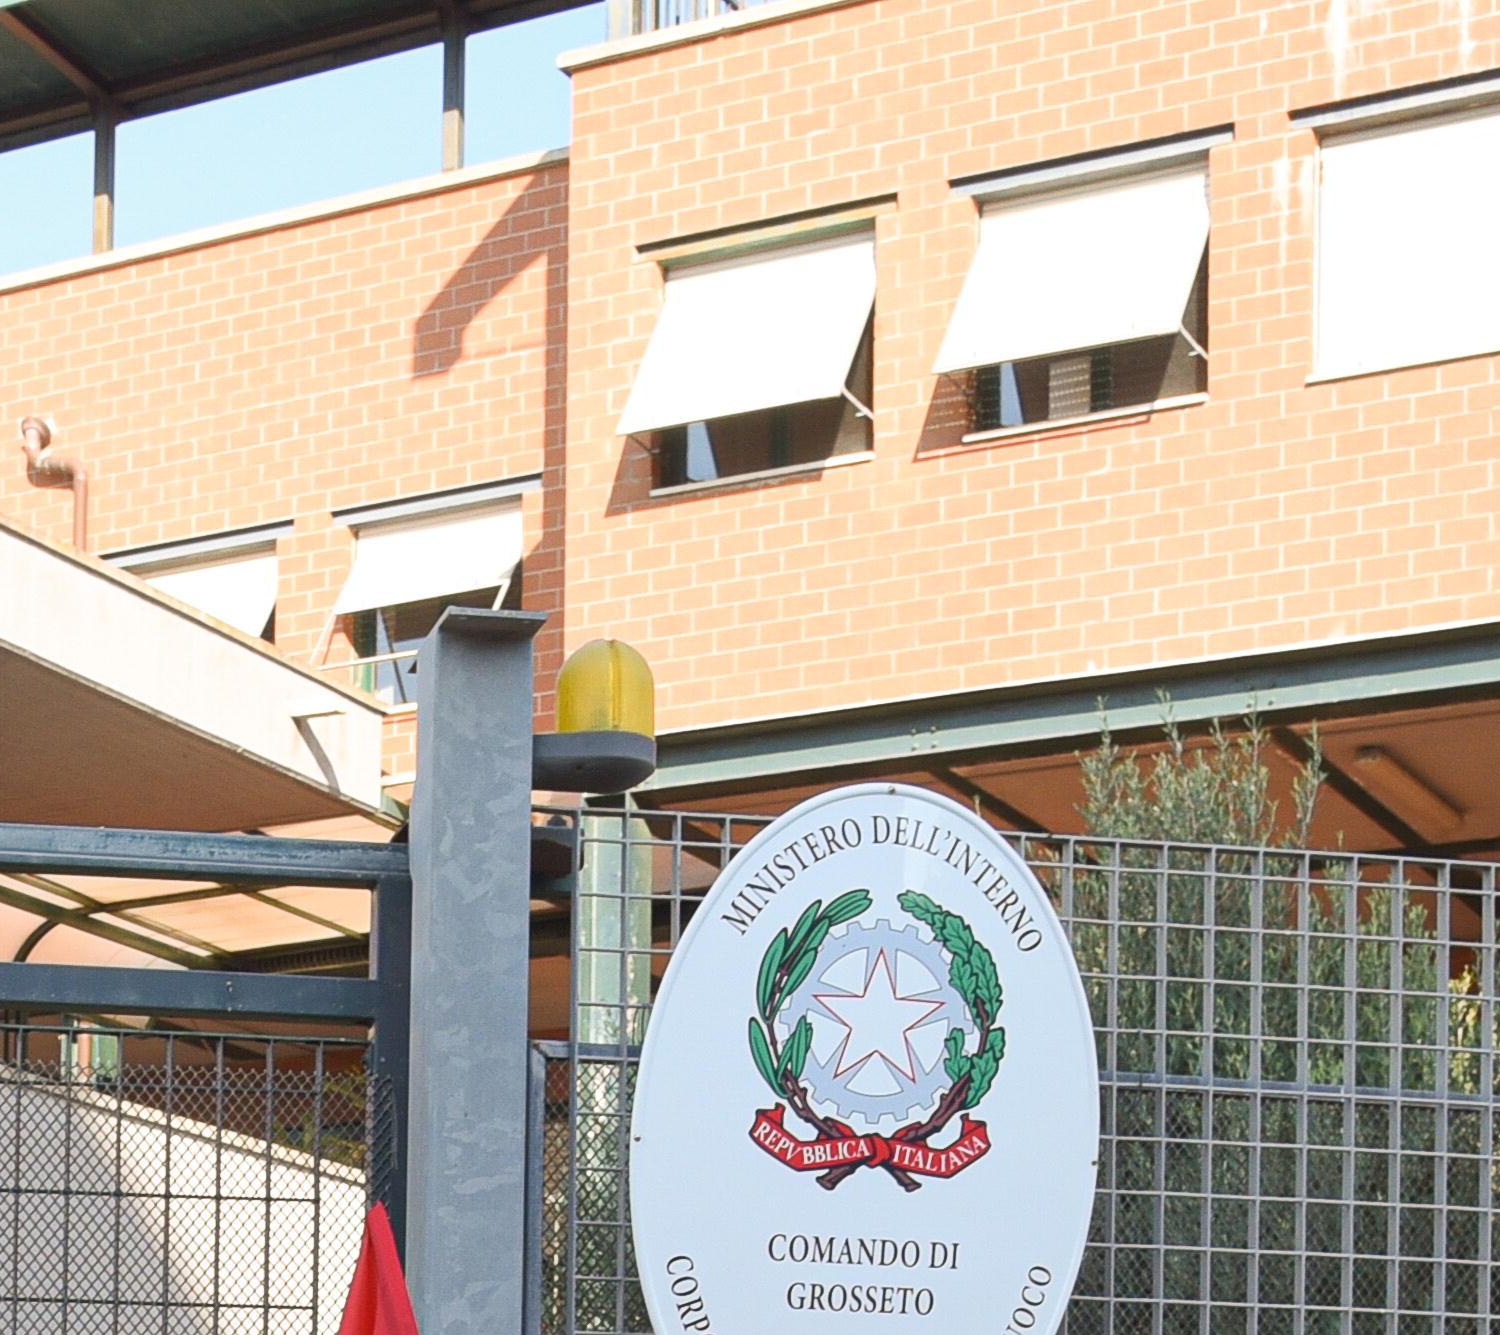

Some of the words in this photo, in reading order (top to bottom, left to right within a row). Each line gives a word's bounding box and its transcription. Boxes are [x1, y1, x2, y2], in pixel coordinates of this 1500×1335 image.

[720, 817, 863, 937] MINISTERO
[872, 814, 1043, 956] DELL'INTERNO
[893, 1134, 988, 1172] ITALIANA
[768, 1233, 920, 1269] COMANDO
[928, 1239, 960, 1270] DI
[786, 1282, 935, 1317] GROSSETO
